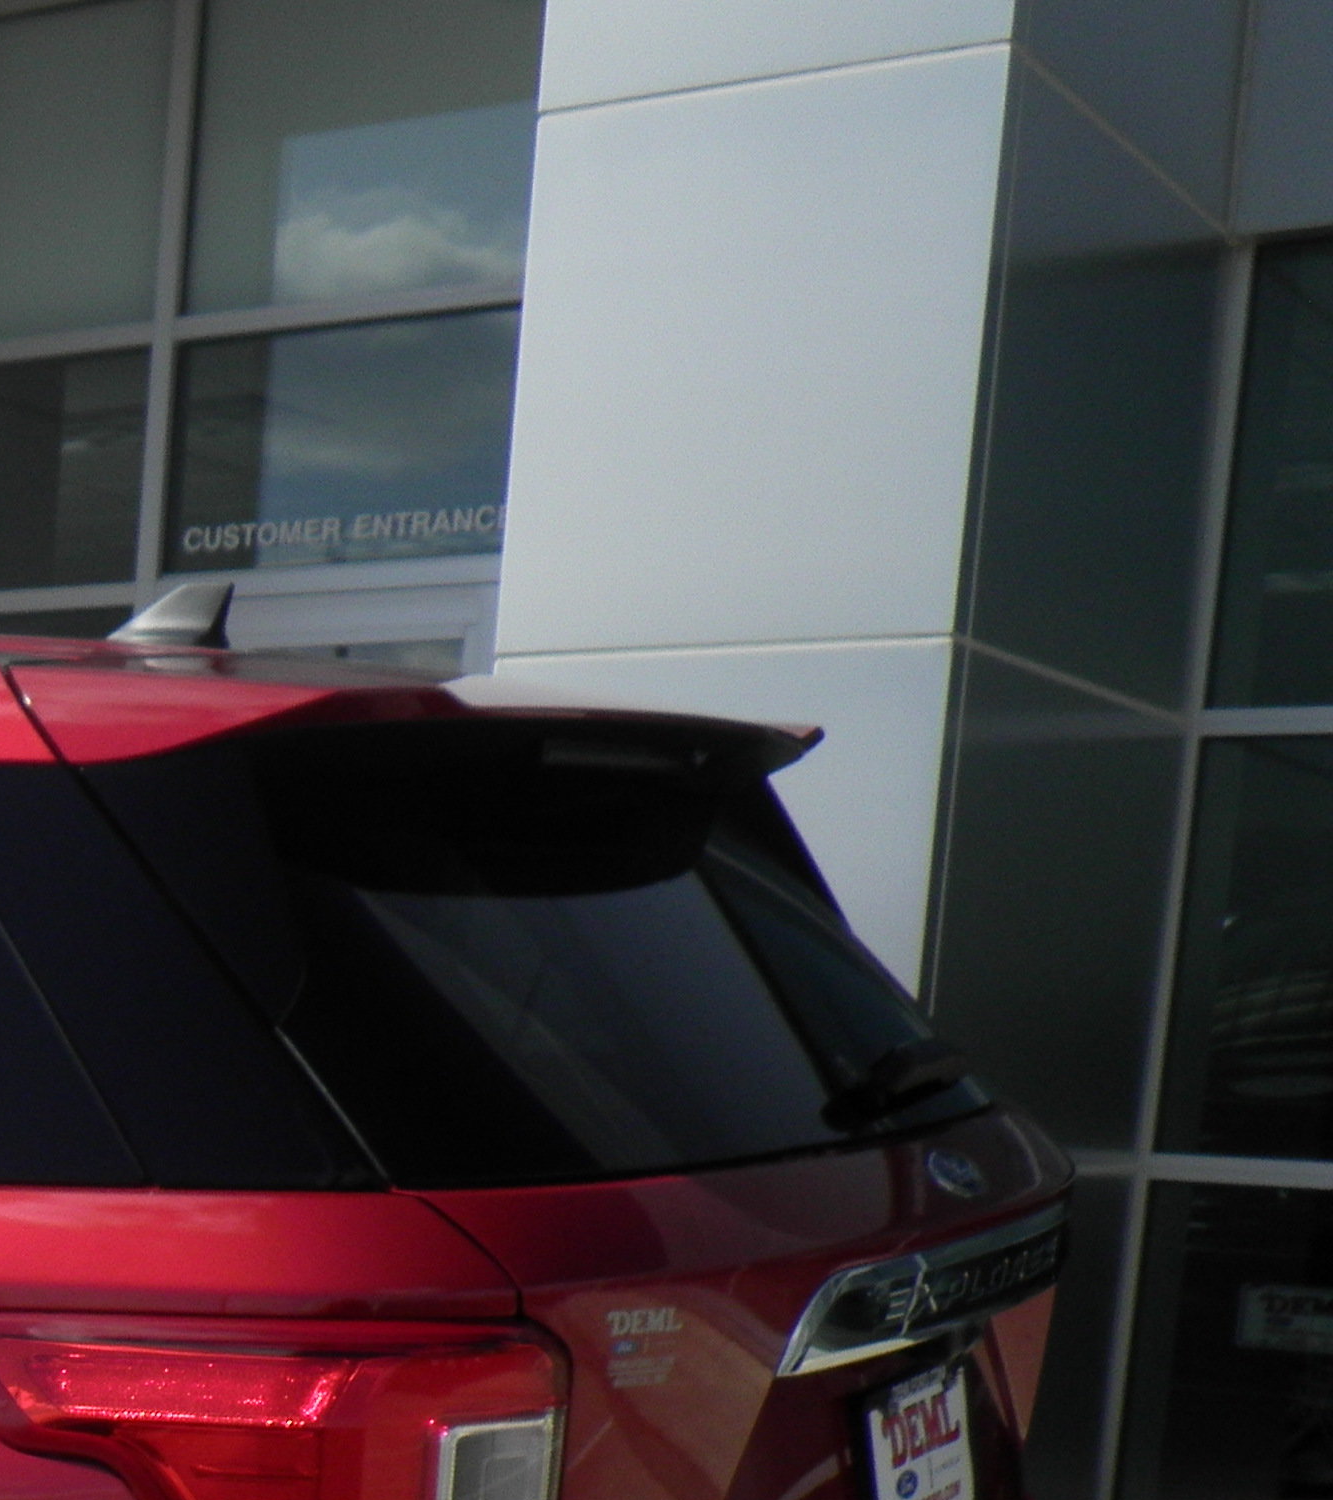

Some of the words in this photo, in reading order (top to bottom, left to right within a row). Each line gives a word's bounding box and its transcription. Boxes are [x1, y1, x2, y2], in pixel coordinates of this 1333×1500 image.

[183, 516, 342, 551] CUSTOMER
[608, 1307, 684, 1335] DEML
[881, 1393, 961, 1469] DEML
